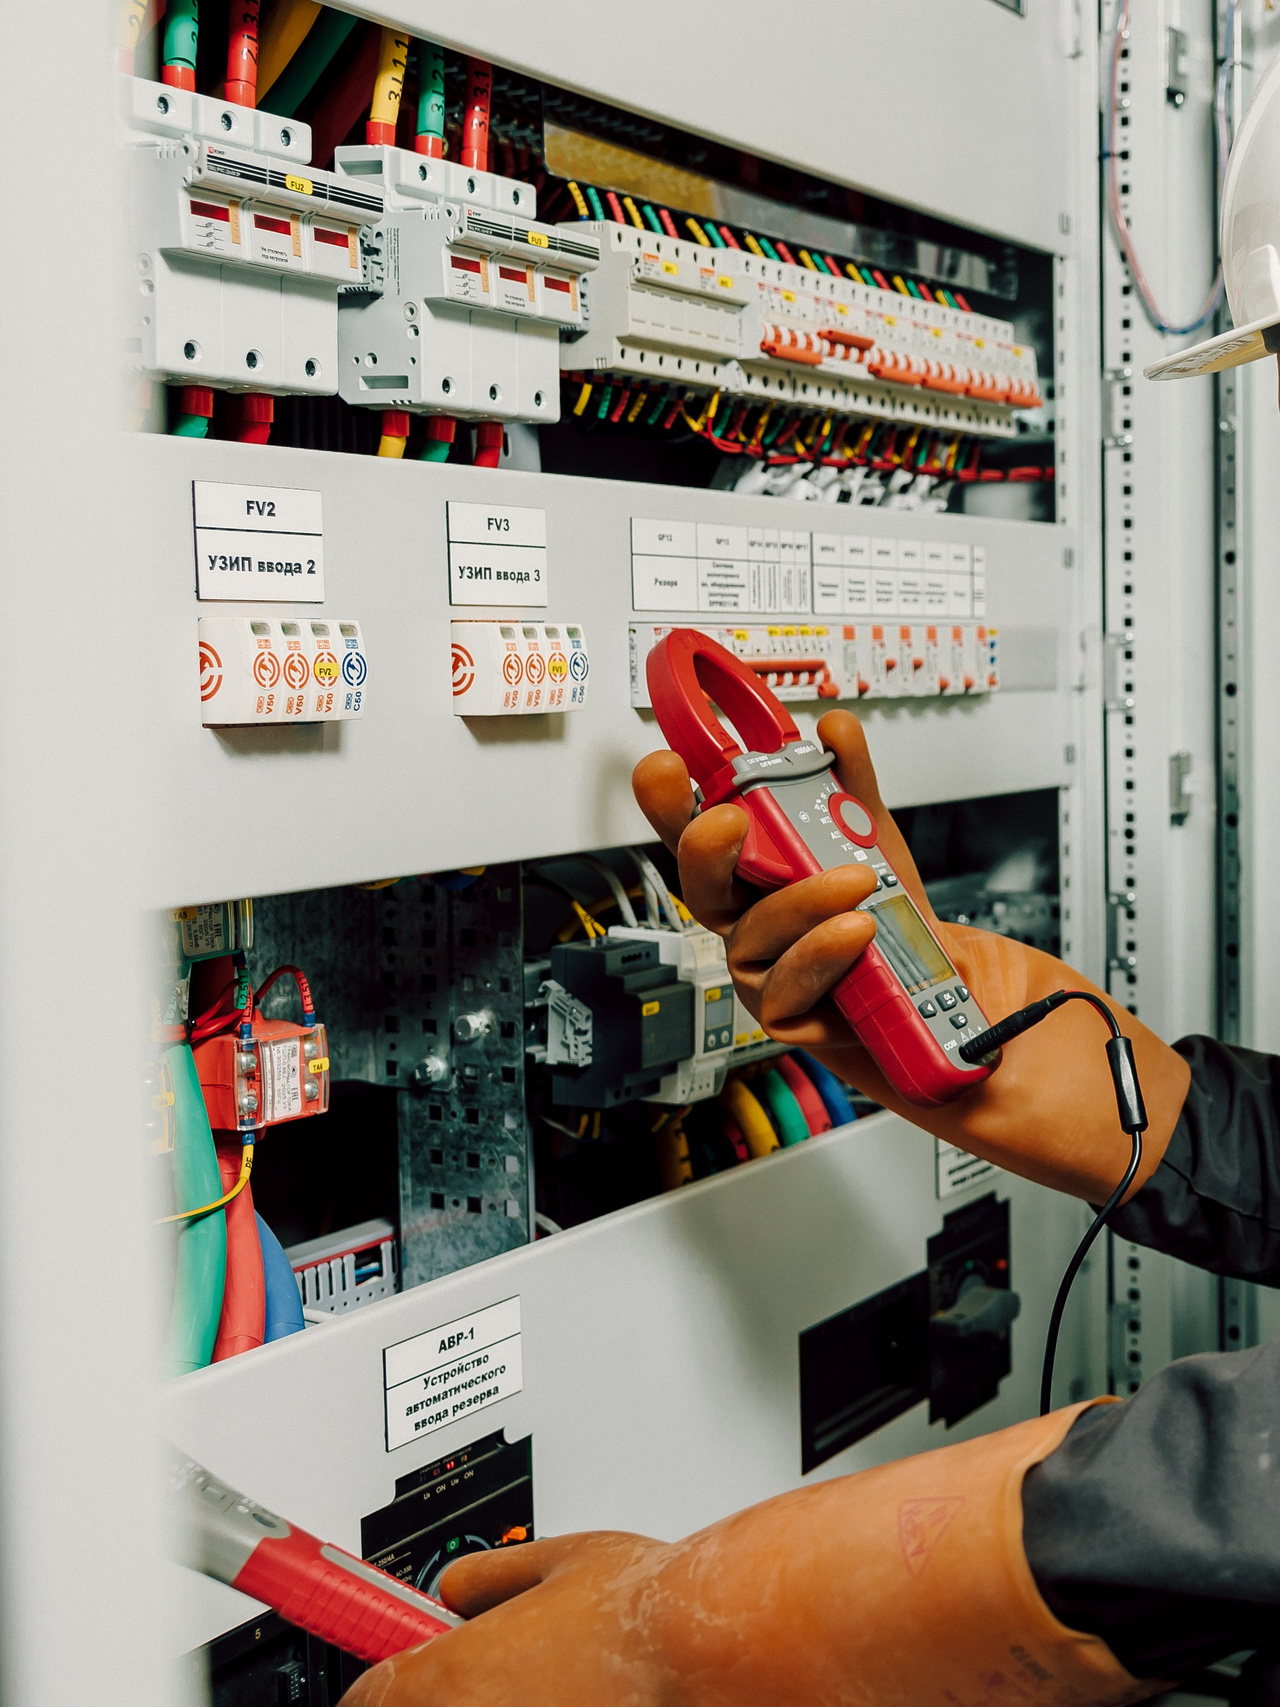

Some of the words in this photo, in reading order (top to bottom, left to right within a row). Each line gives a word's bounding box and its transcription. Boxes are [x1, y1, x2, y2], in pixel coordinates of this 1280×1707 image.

[290, 181, 304, 192] FU2
[246, 500, 276, 517] FV2
[487, 517, 510, 532] FV3
[208, 555, 252, 572] УЗИП
[257, 560, 302, 577] ввода
[306, 559, 316, 575] 2
[458, 565, 492, 580] УЗИП
[496, 571, 530, 584] ввода
[534, 569, 541, 582] 3
[318, 667, 332, 676] FV2
[265, 693, 275, 715] V50
[295, 694, 304, 715] V50
[324, 692, 334, 713] V50
[354, 691, 362, 711] C50
[511, 690, 519, 708] V50
[533, 689, 541, 708] V50
[556, 688, 564, 706] V50
[173, 911, 187, 919] TA5
[943, 1039, 958, 1051] COM
[313, 1063, 323, 1072] TA6
[438, 1327, 474, 1354] АВР-1
[423, 1354, 489, 1390] Устройство
[405, 1364, 506, 1417] автоматического
[414, 1408, 449, 1432] ввода
[452, 1386, 500, 1416] резерва
[435, 1483, 446, 1494] ON
[463, 1470, 474, 1480] ON
[255, 1628, 261, 1640] 5
